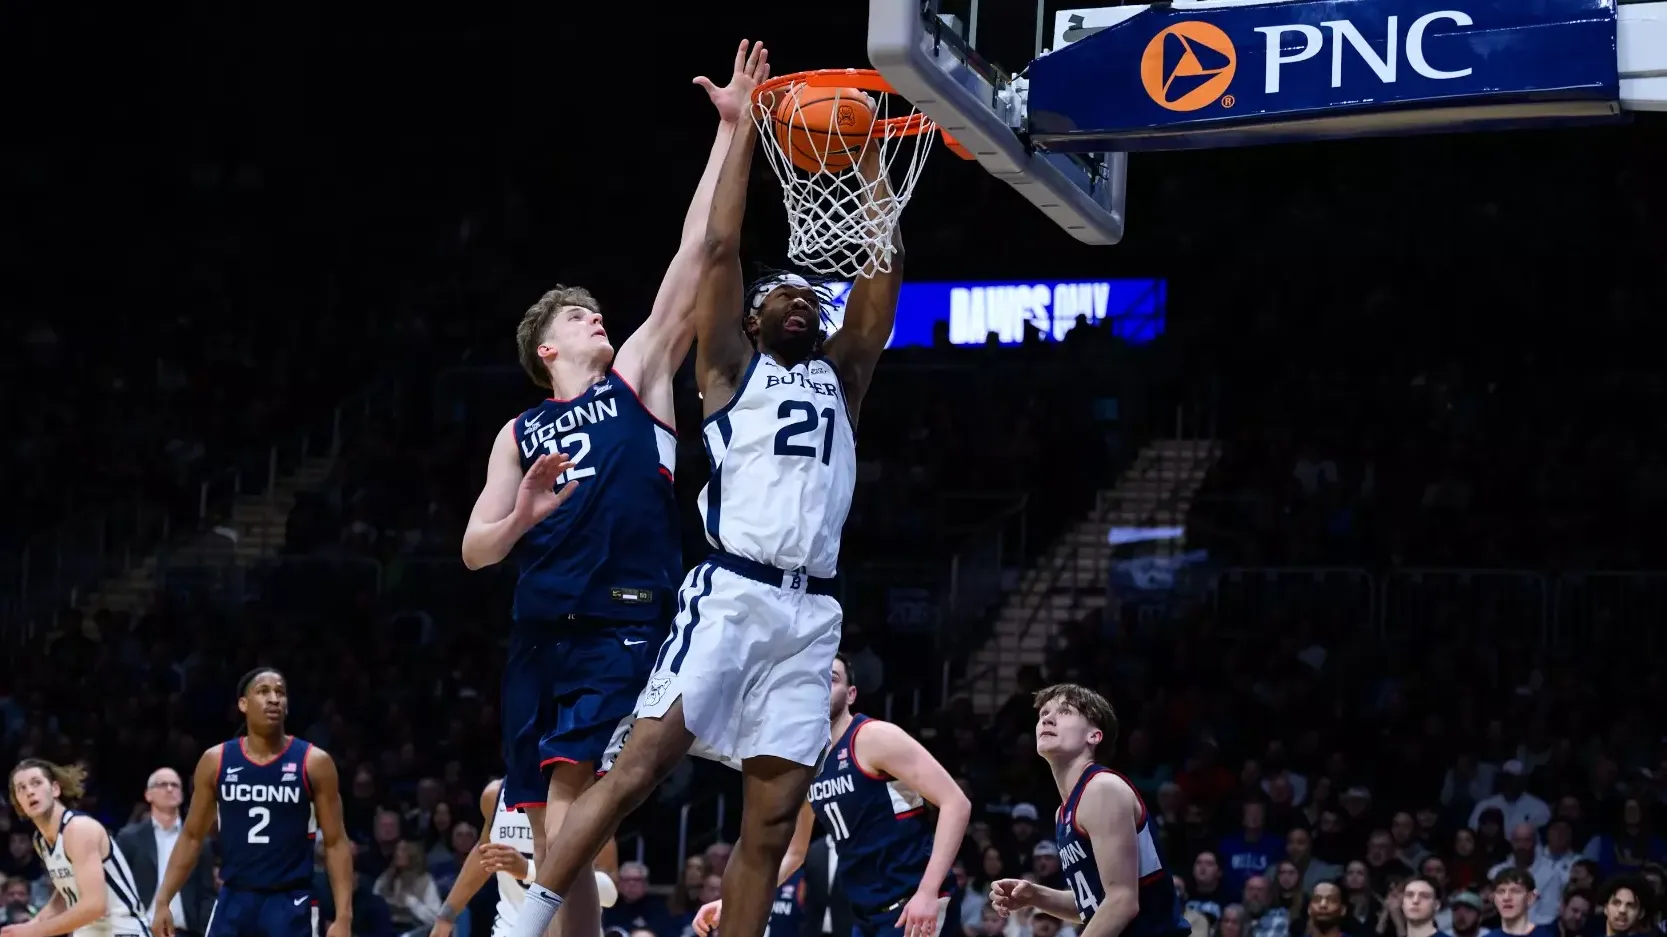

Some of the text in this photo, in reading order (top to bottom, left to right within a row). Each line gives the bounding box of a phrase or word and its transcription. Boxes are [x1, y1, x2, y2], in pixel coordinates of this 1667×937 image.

[1254, 10, 1473, 94] PNC
[520, 397, 618, 459] UCONN
[774, 399, 836, 466] 21
[543, 432, 596, 485] 12
[220, 783, 301, 804] UCONN
[806, 773, 855, 803] UCONN
[247, 805, 271, 844] 2
[499, 826, 533, 840] BUTL
[823, 801, 851, 841] 11
